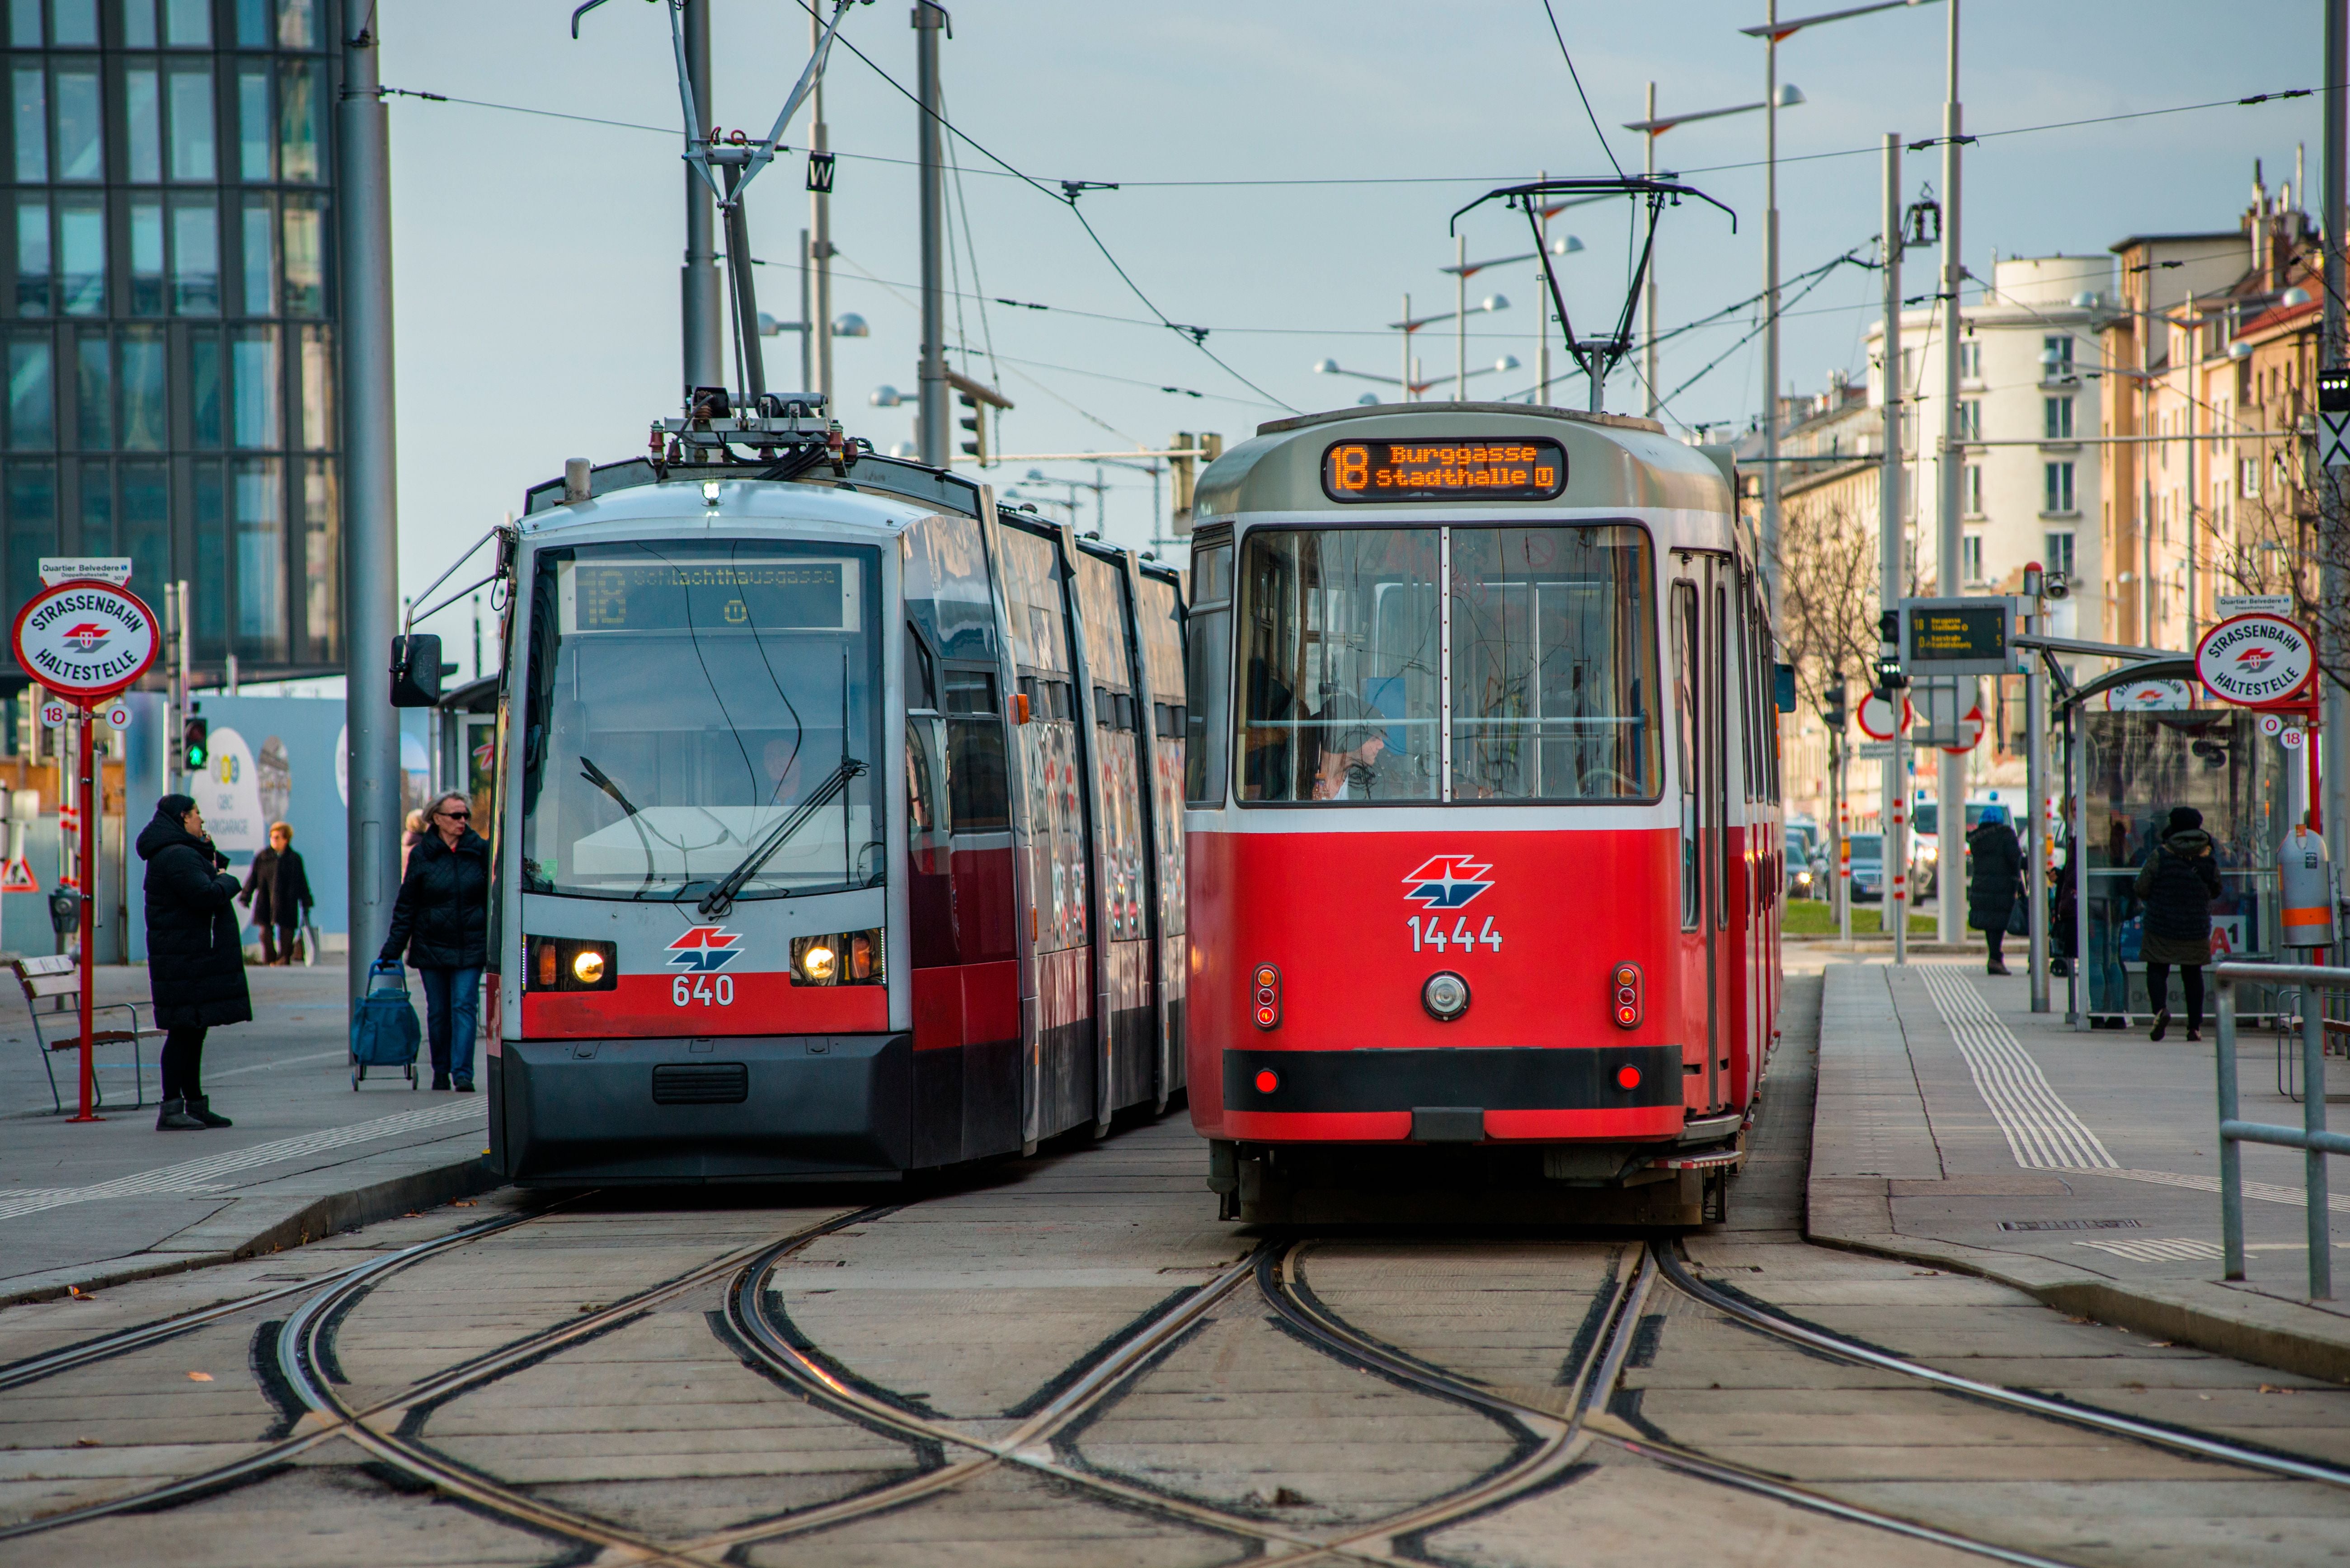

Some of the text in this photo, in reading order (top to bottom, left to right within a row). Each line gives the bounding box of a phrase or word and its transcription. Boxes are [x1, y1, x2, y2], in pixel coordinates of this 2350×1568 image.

[809, 160, 834, 188] W
[1331, 446, 1368, 489] 18
[1390, 446, 1537, 465] Burggasse
[31, 595, 143, 633] STRASSENBAHN
[1997, 617, 2002, 630] 1
[1995, 634, 2002, 647] 5
[2208, 624, 2302, 658] STRASSENBAHN
[34, 648, 138, 681] HALTESTELLE
[2214, 666, 2299, 695] HALTESTELLE
[44, 708, 63, 722] 18
[2284, 732, 2301, 746] 18
[1405, 915, 1503, 953] 1444
[672, 975, 734, 1008] 640
